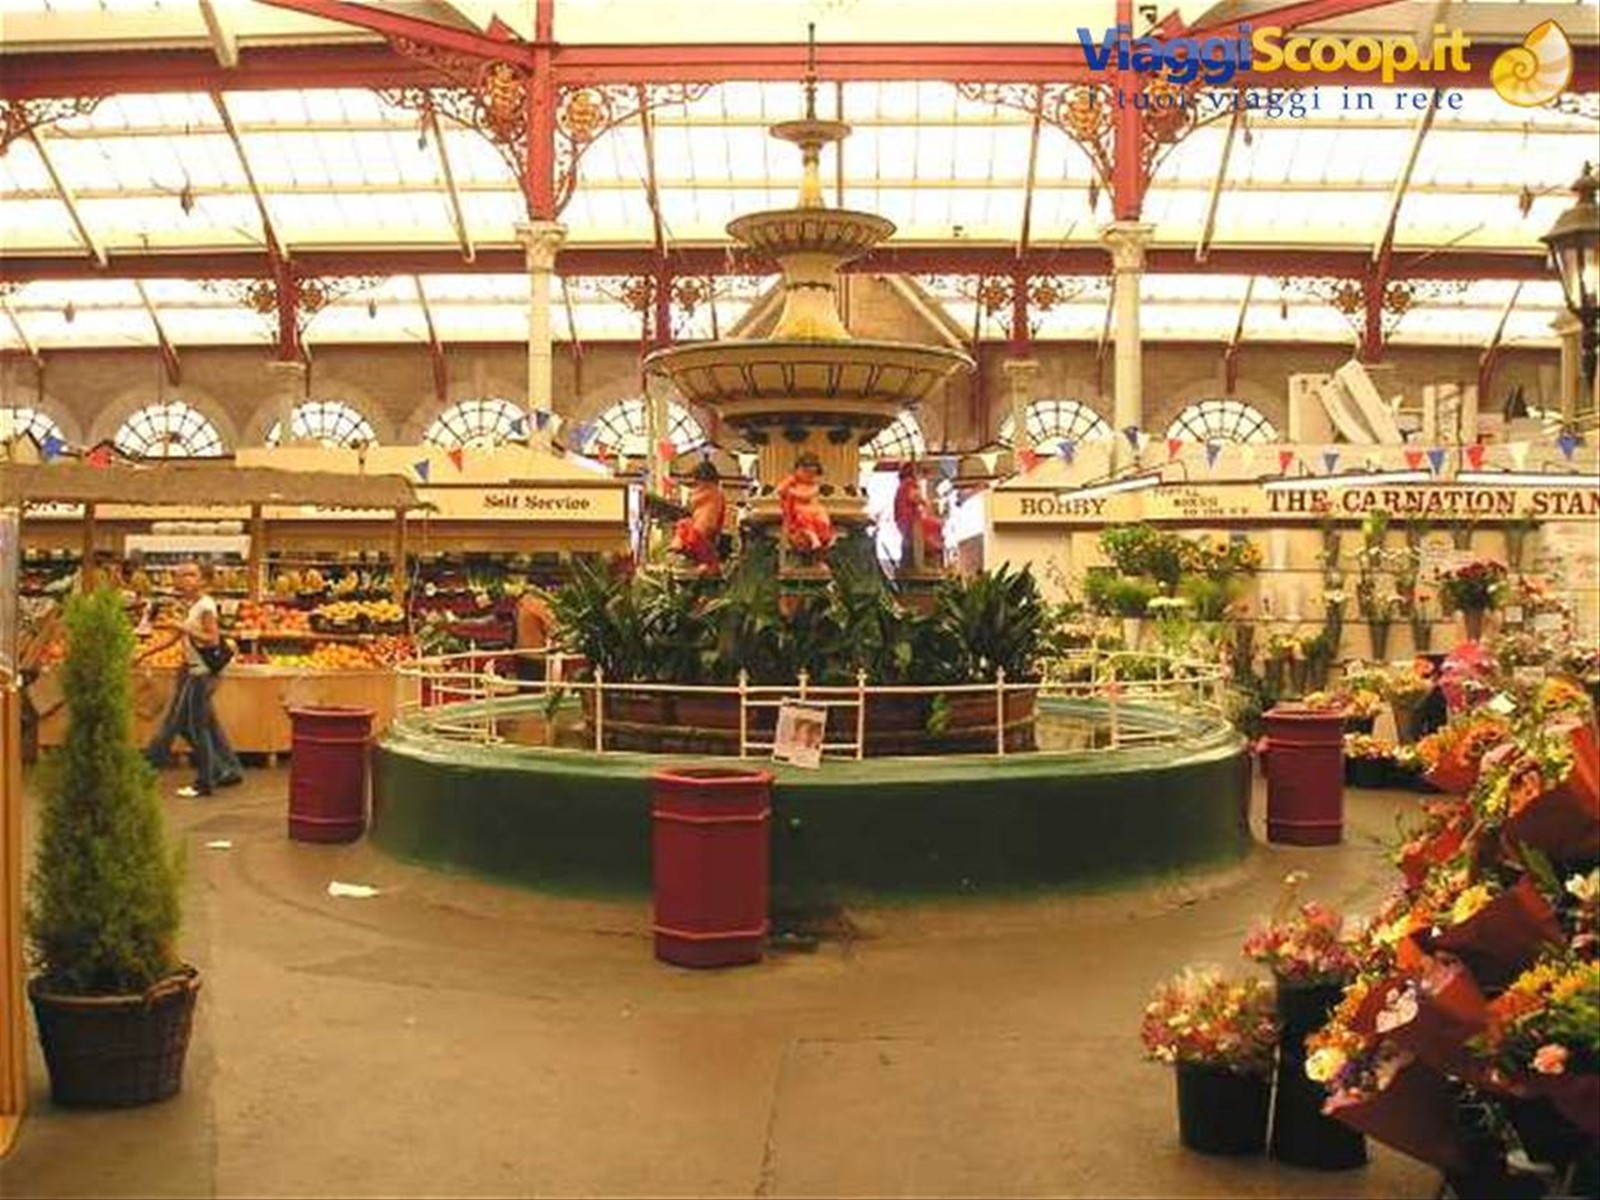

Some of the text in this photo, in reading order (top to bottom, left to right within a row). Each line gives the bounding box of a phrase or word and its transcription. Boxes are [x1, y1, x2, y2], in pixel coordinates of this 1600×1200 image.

[484, 494, 591, 510] Self Service
[1266, 489, 1330, 512] THE
[1342, 490, 1517, 514] CARNATION
